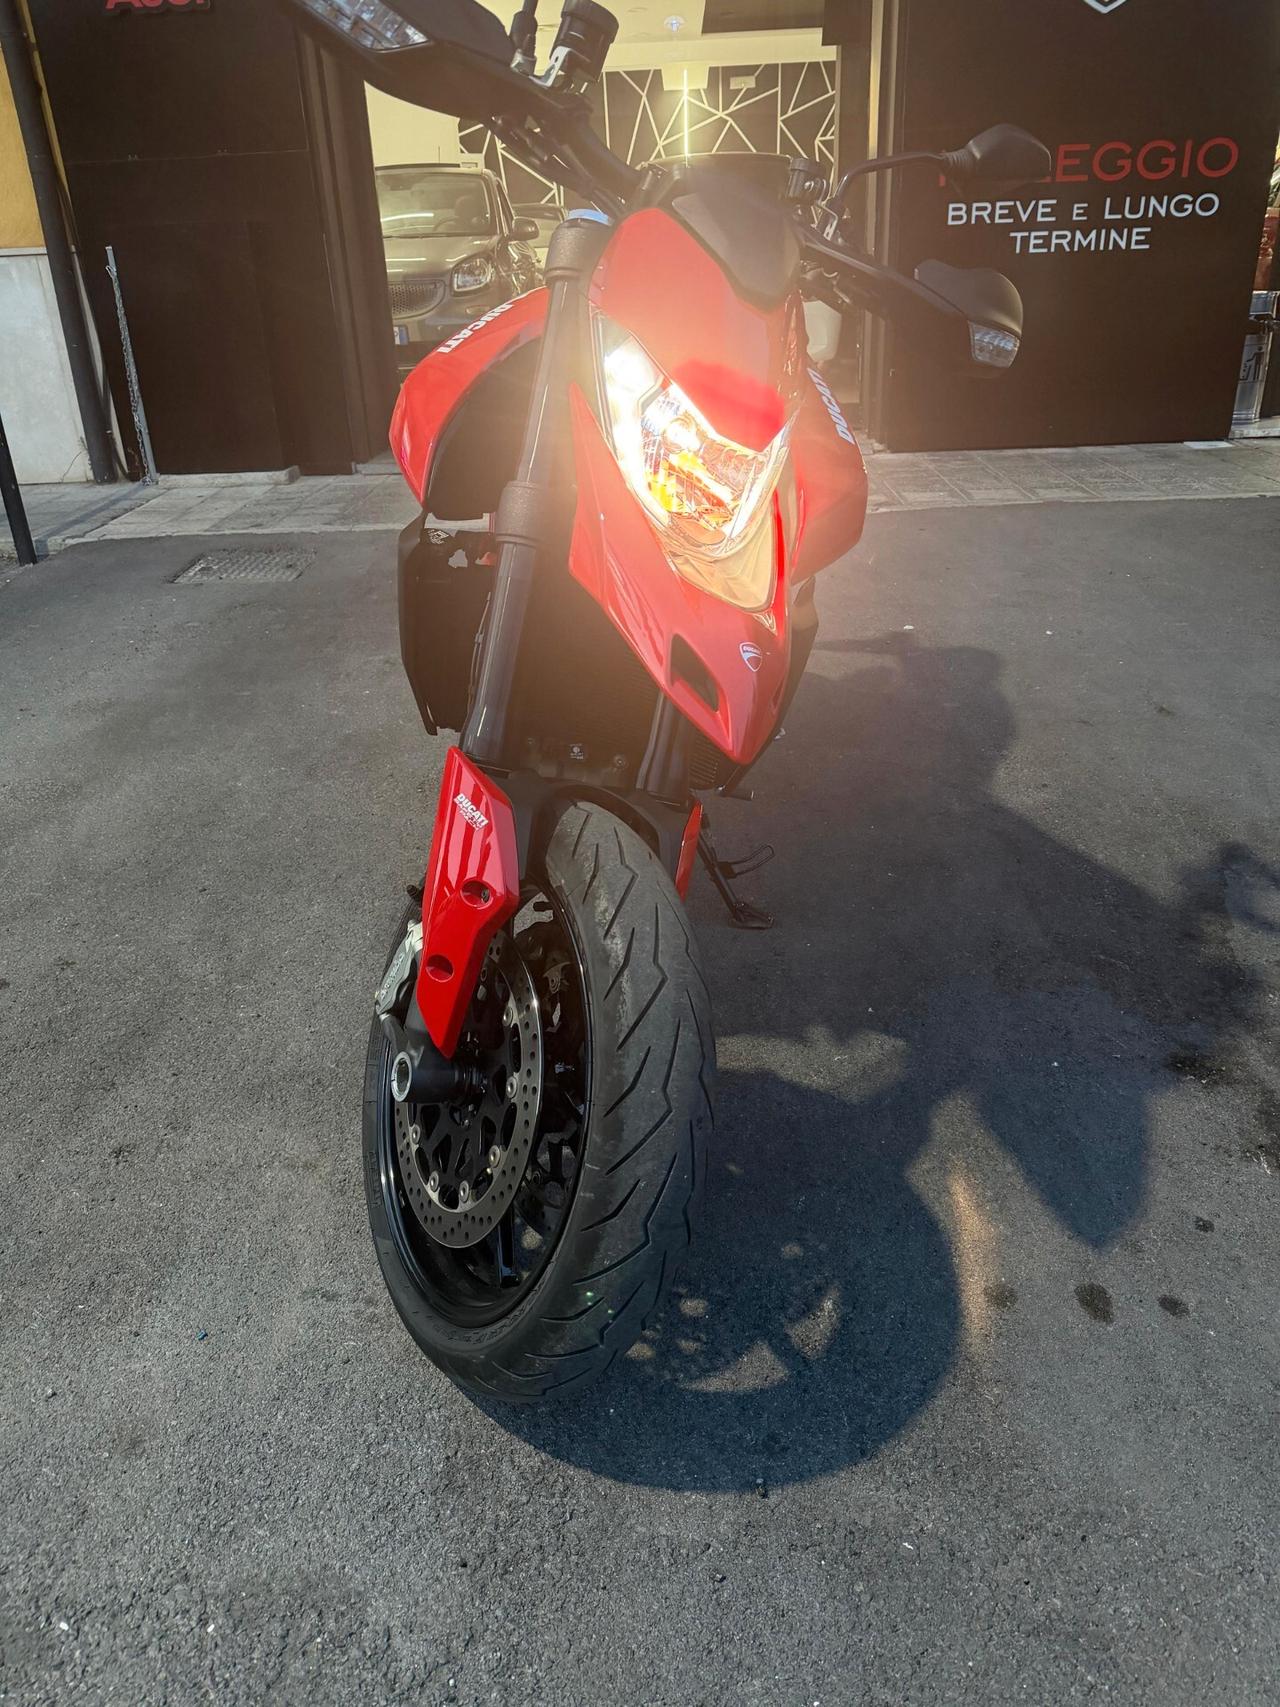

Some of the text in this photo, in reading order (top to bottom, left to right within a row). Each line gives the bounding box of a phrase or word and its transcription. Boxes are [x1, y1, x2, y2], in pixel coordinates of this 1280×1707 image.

[947, 192, 1220, 225] BREVE E LUNGO
[1009, 227, 1152, 254] TERMINE
[437, 303, 515, 353] DUCATI
[457, 793, 489, 826] DUCATI
